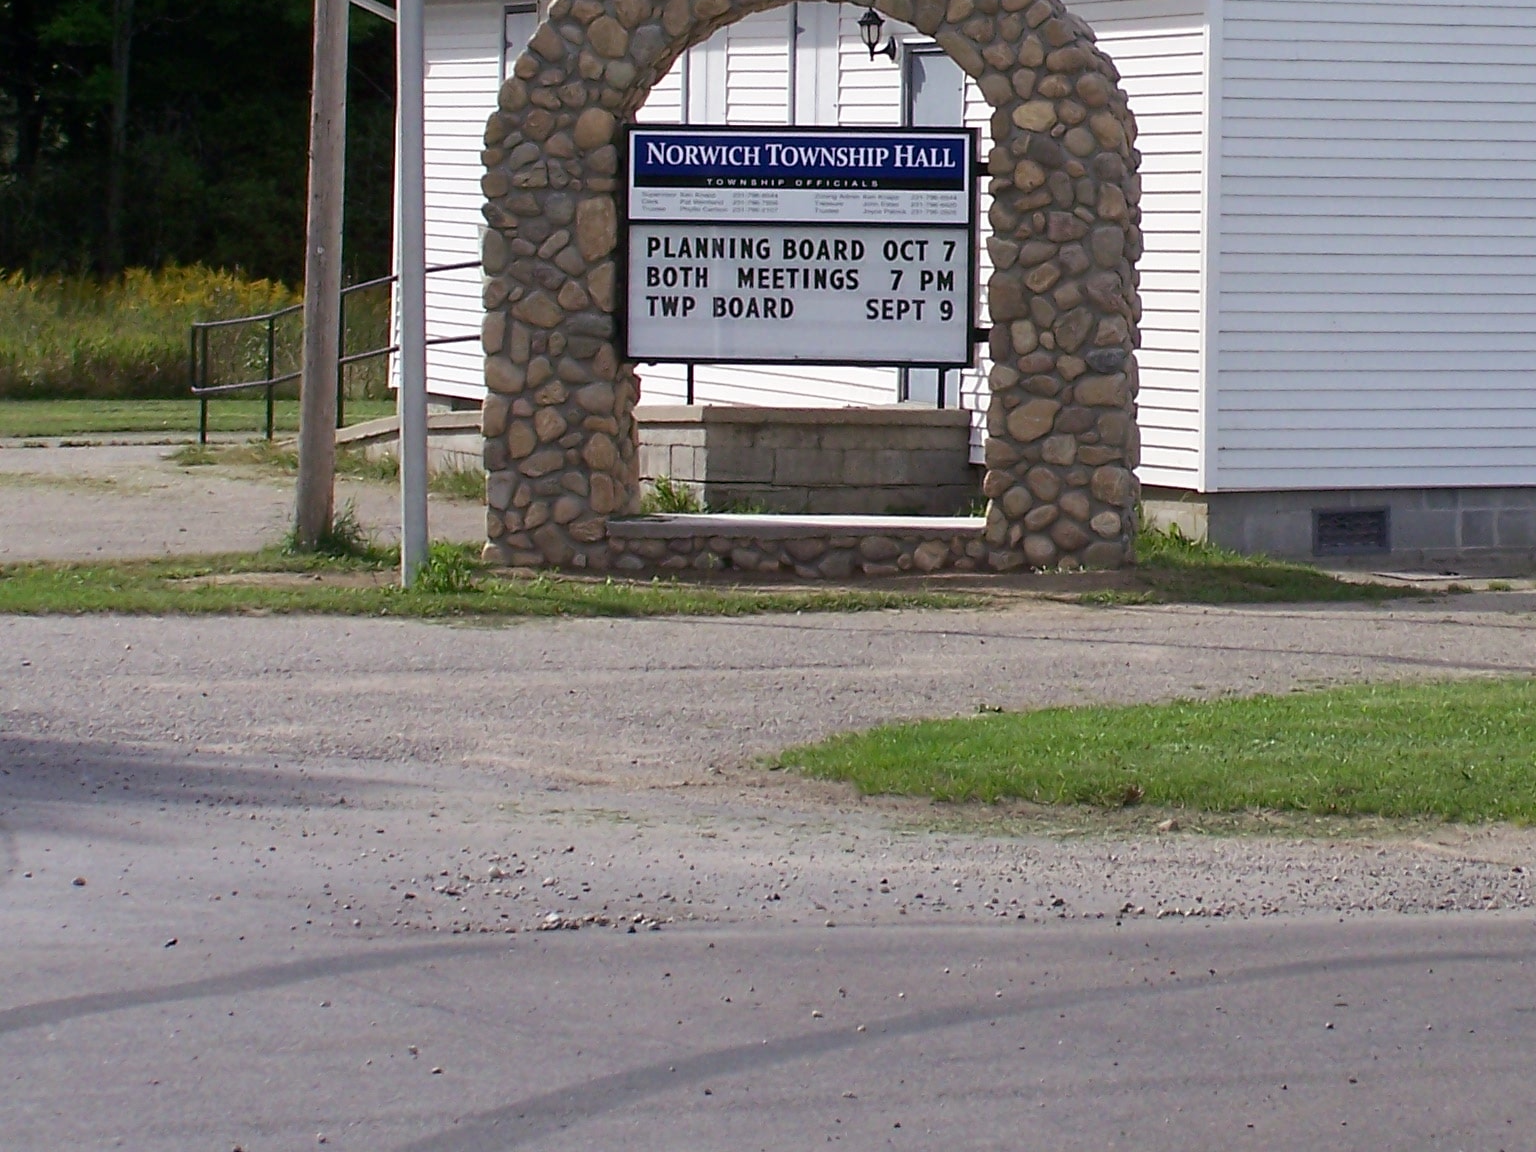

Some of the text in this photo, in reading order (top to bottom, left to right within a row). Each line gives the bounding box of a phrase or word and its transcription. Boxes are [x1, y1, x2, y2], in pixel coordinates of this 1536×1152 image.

[646, 142, 956, 168] NORWICH TOWNSHIP HALL
[706, 178, 879, 187] TOWNSHIP OFFICIALS
[647, 236, 956, 262] PLANNING BOARD OCT 7
[646, 266, 955, 291] BOTH MEETINGS 7 PM
[646, 296, 954, 321] TWP BOARD SEPT 9
